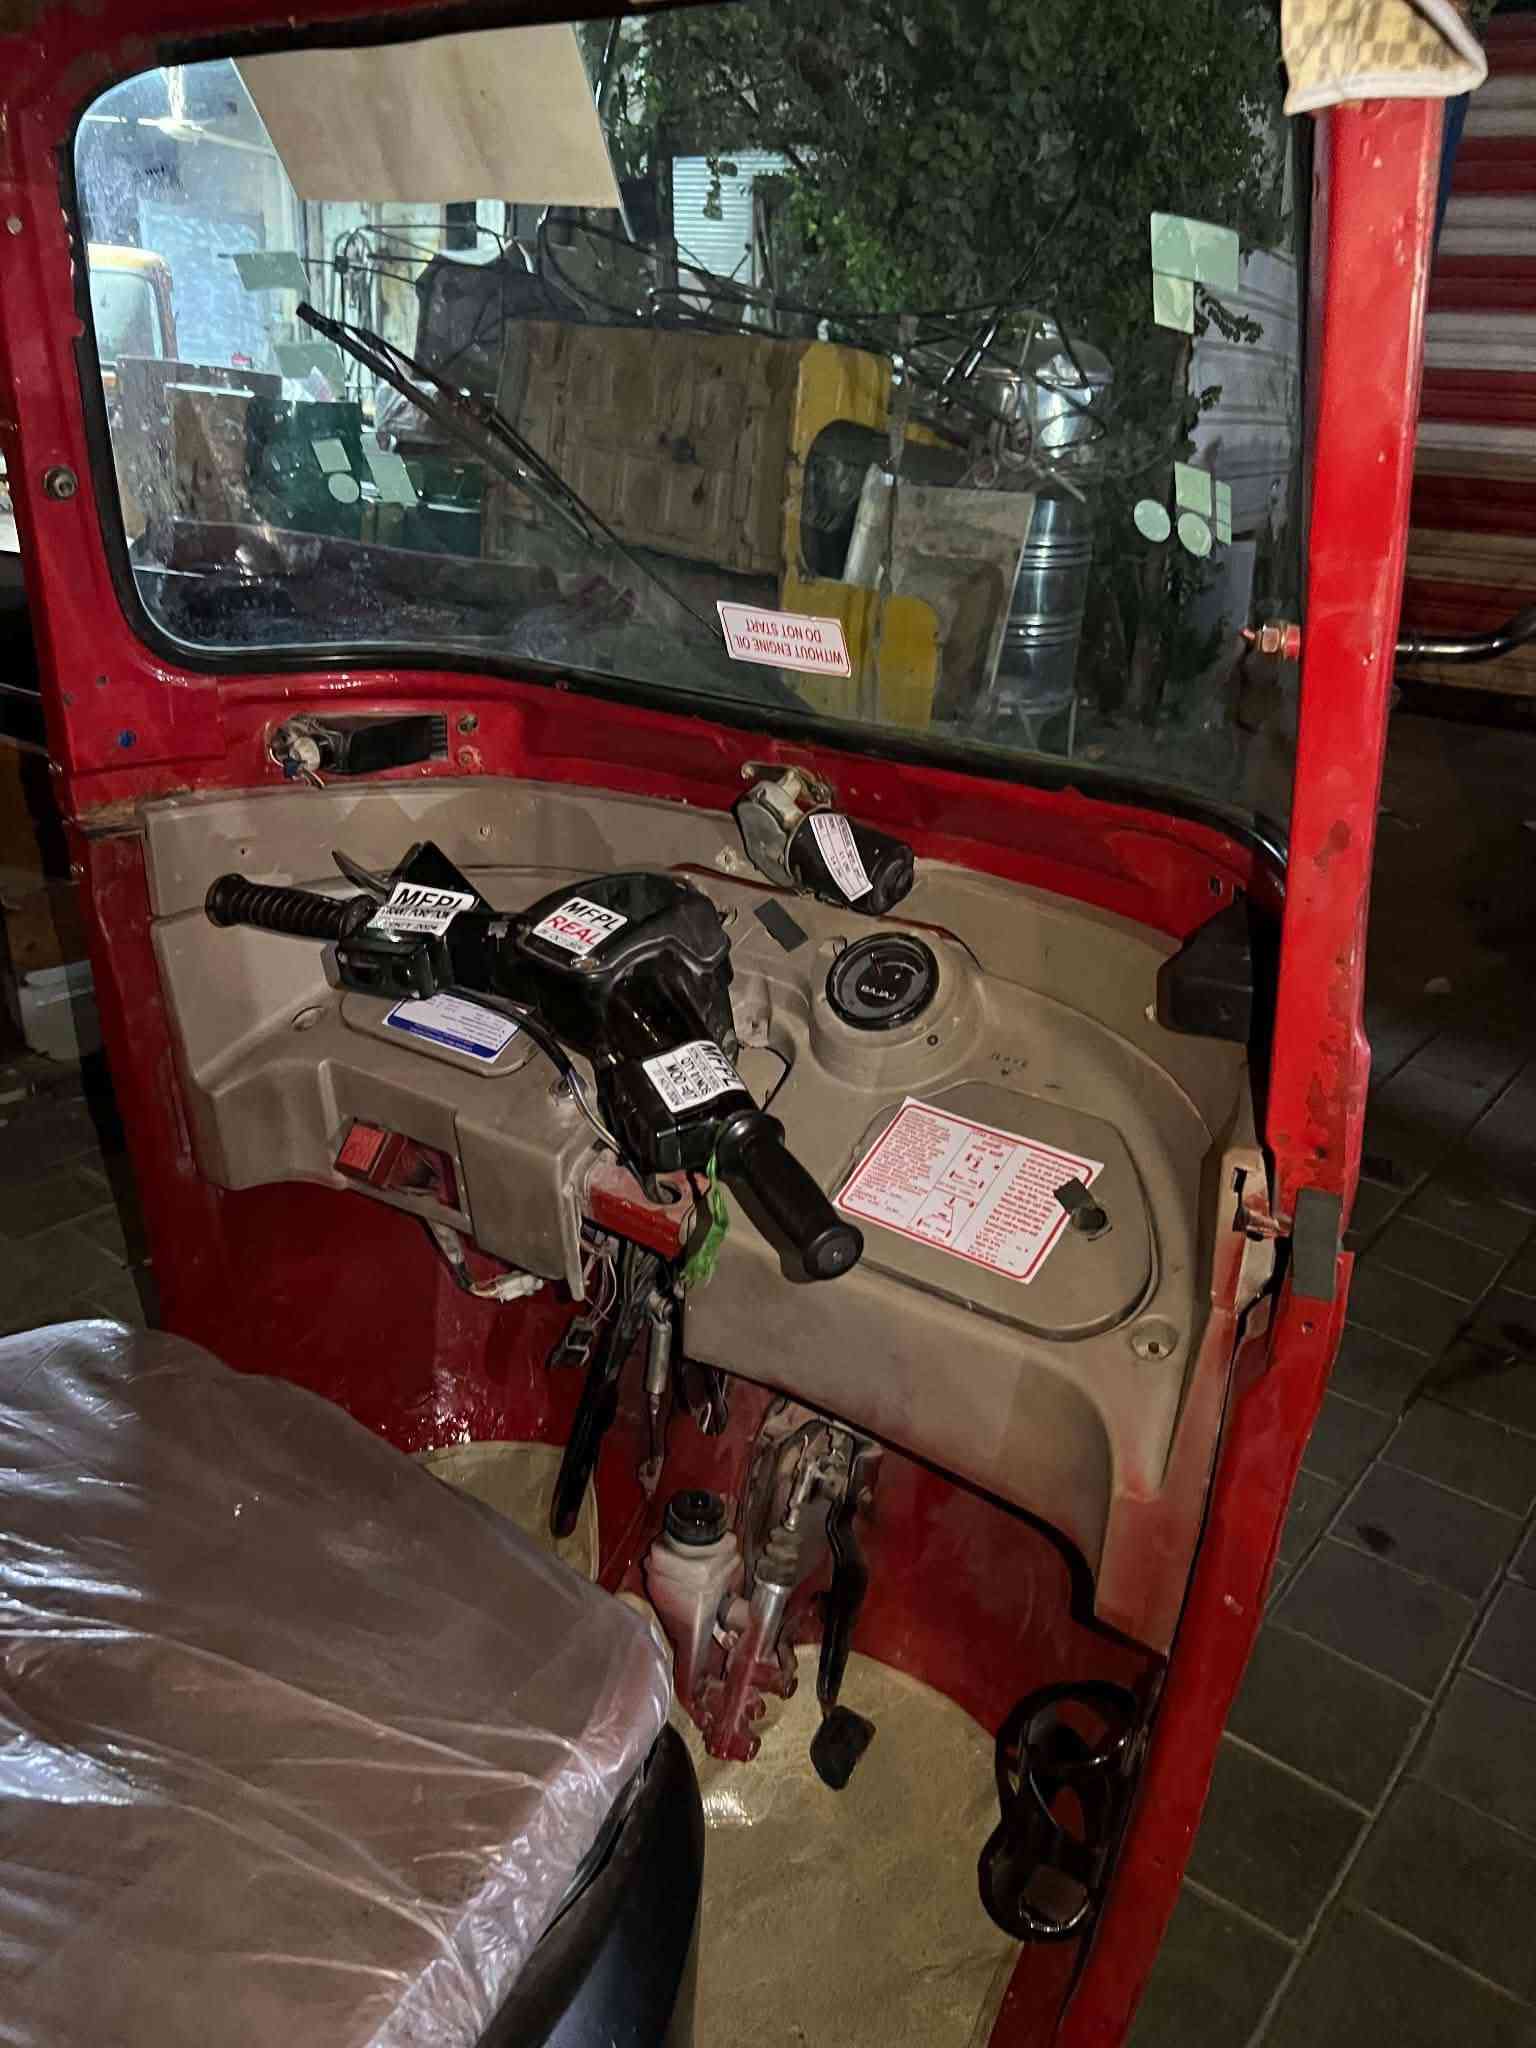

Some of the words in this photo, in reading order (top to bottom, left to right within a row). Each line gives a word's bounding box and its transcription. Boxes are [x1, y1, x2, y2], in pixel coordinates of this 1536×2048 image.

[746, 618, 778, 635] START
[782, 624, 804, 639] NOT
[806, 627, 821, 643] DO
[735, 632, 751, 650] OIL
[753, 638, 792, 656] ENGINE
[796, 646, 843, 664] WITHOUT
[562, 901, 619, 931] MFPL
[544, 915, 602, 945] REAL
